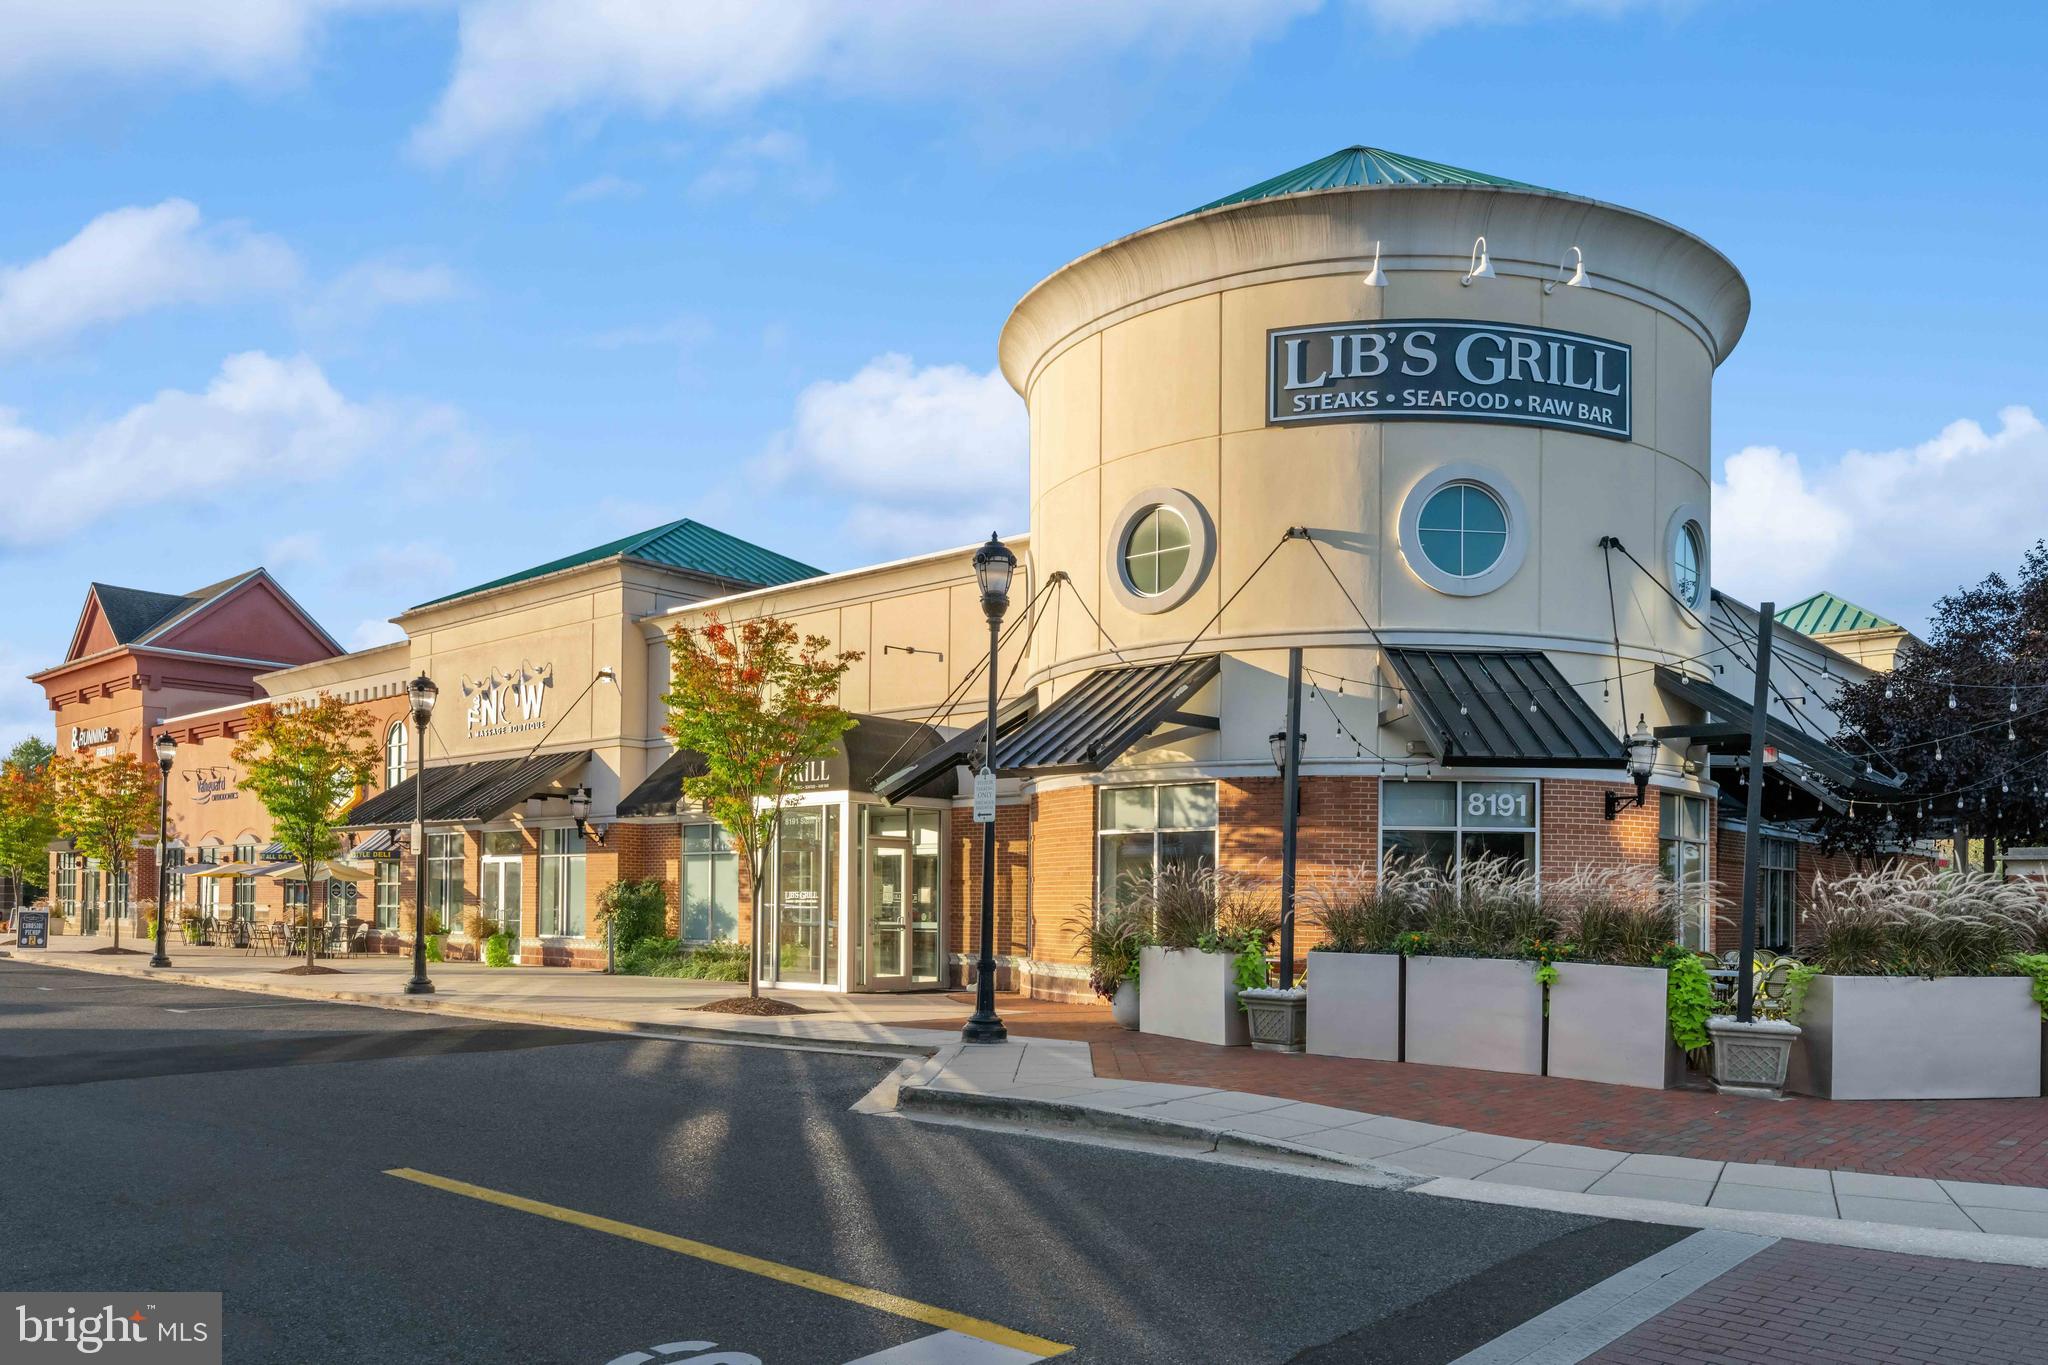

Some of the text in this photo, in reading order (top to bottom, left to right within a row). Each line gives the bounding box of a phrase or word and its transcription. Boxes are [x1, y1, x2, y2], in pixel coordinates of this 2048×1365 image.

[1283, 331, 1621, 396] LIB'S GRILL
[1293, 389, 1613, 425] STEAKS SEAFOOD RAW BAR
[474, 726, 507, 737] MASSAGE
[510, 720, 546, 733] BOUTIQUE
[1468, 793, 1527, 817] 8191
